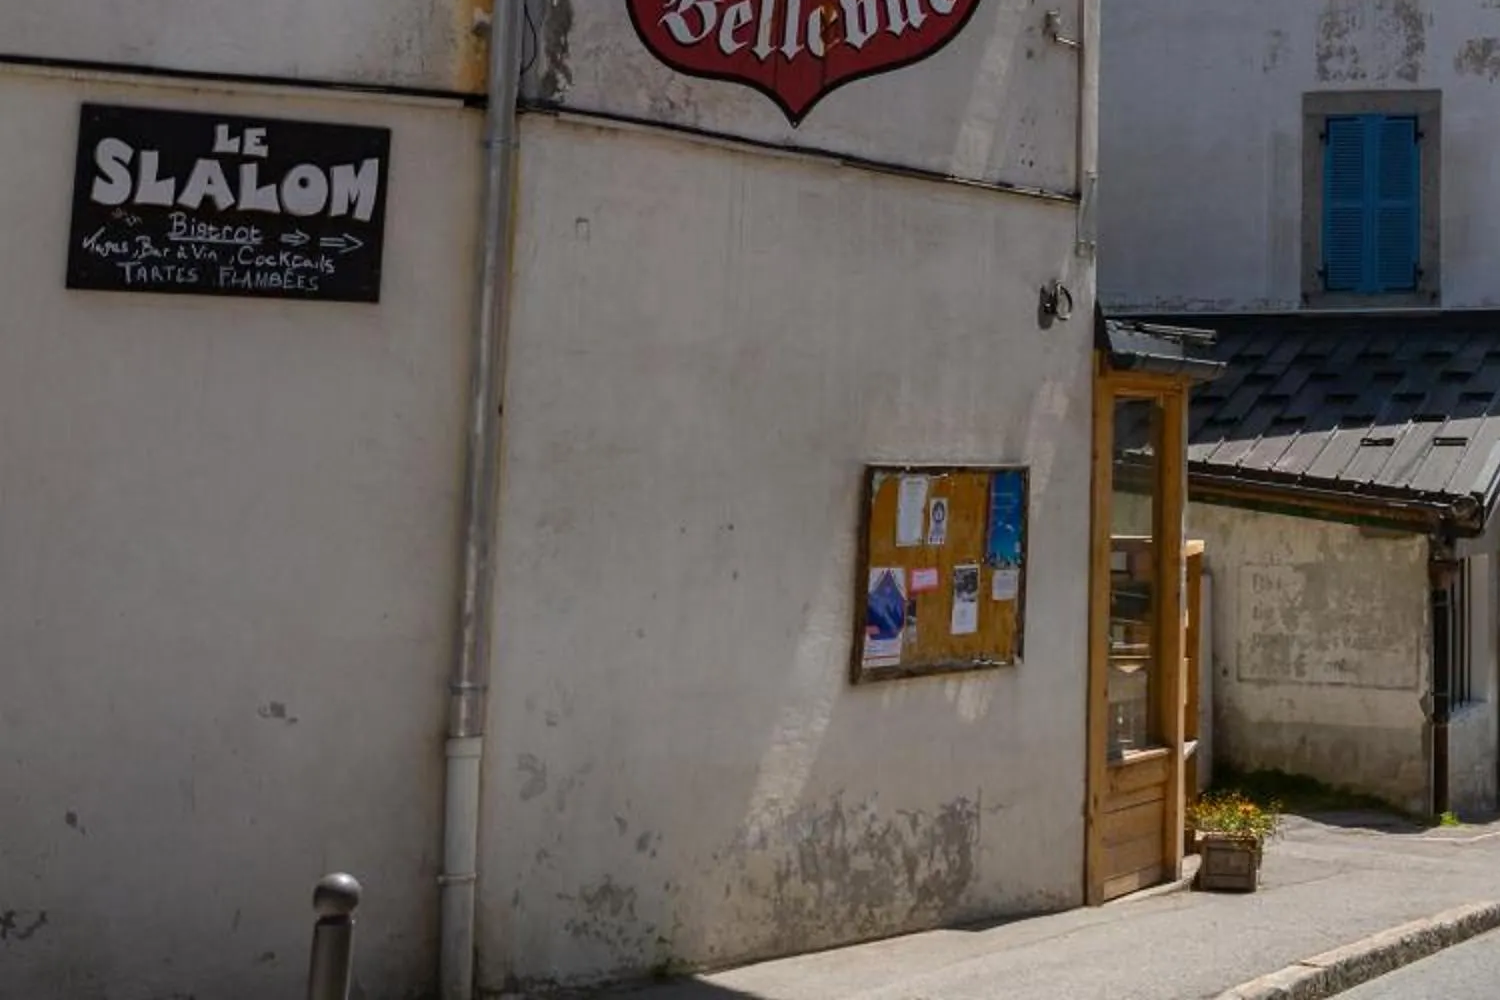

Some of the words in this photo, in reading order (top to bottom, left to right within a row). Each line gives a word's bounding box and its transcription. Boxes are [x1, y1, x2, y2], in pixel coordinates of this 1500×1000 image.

[212, 123, 269, 157] LE
[91, 136, 380, 222] SLALOM
[116, 261, 199, 285] TARTES
